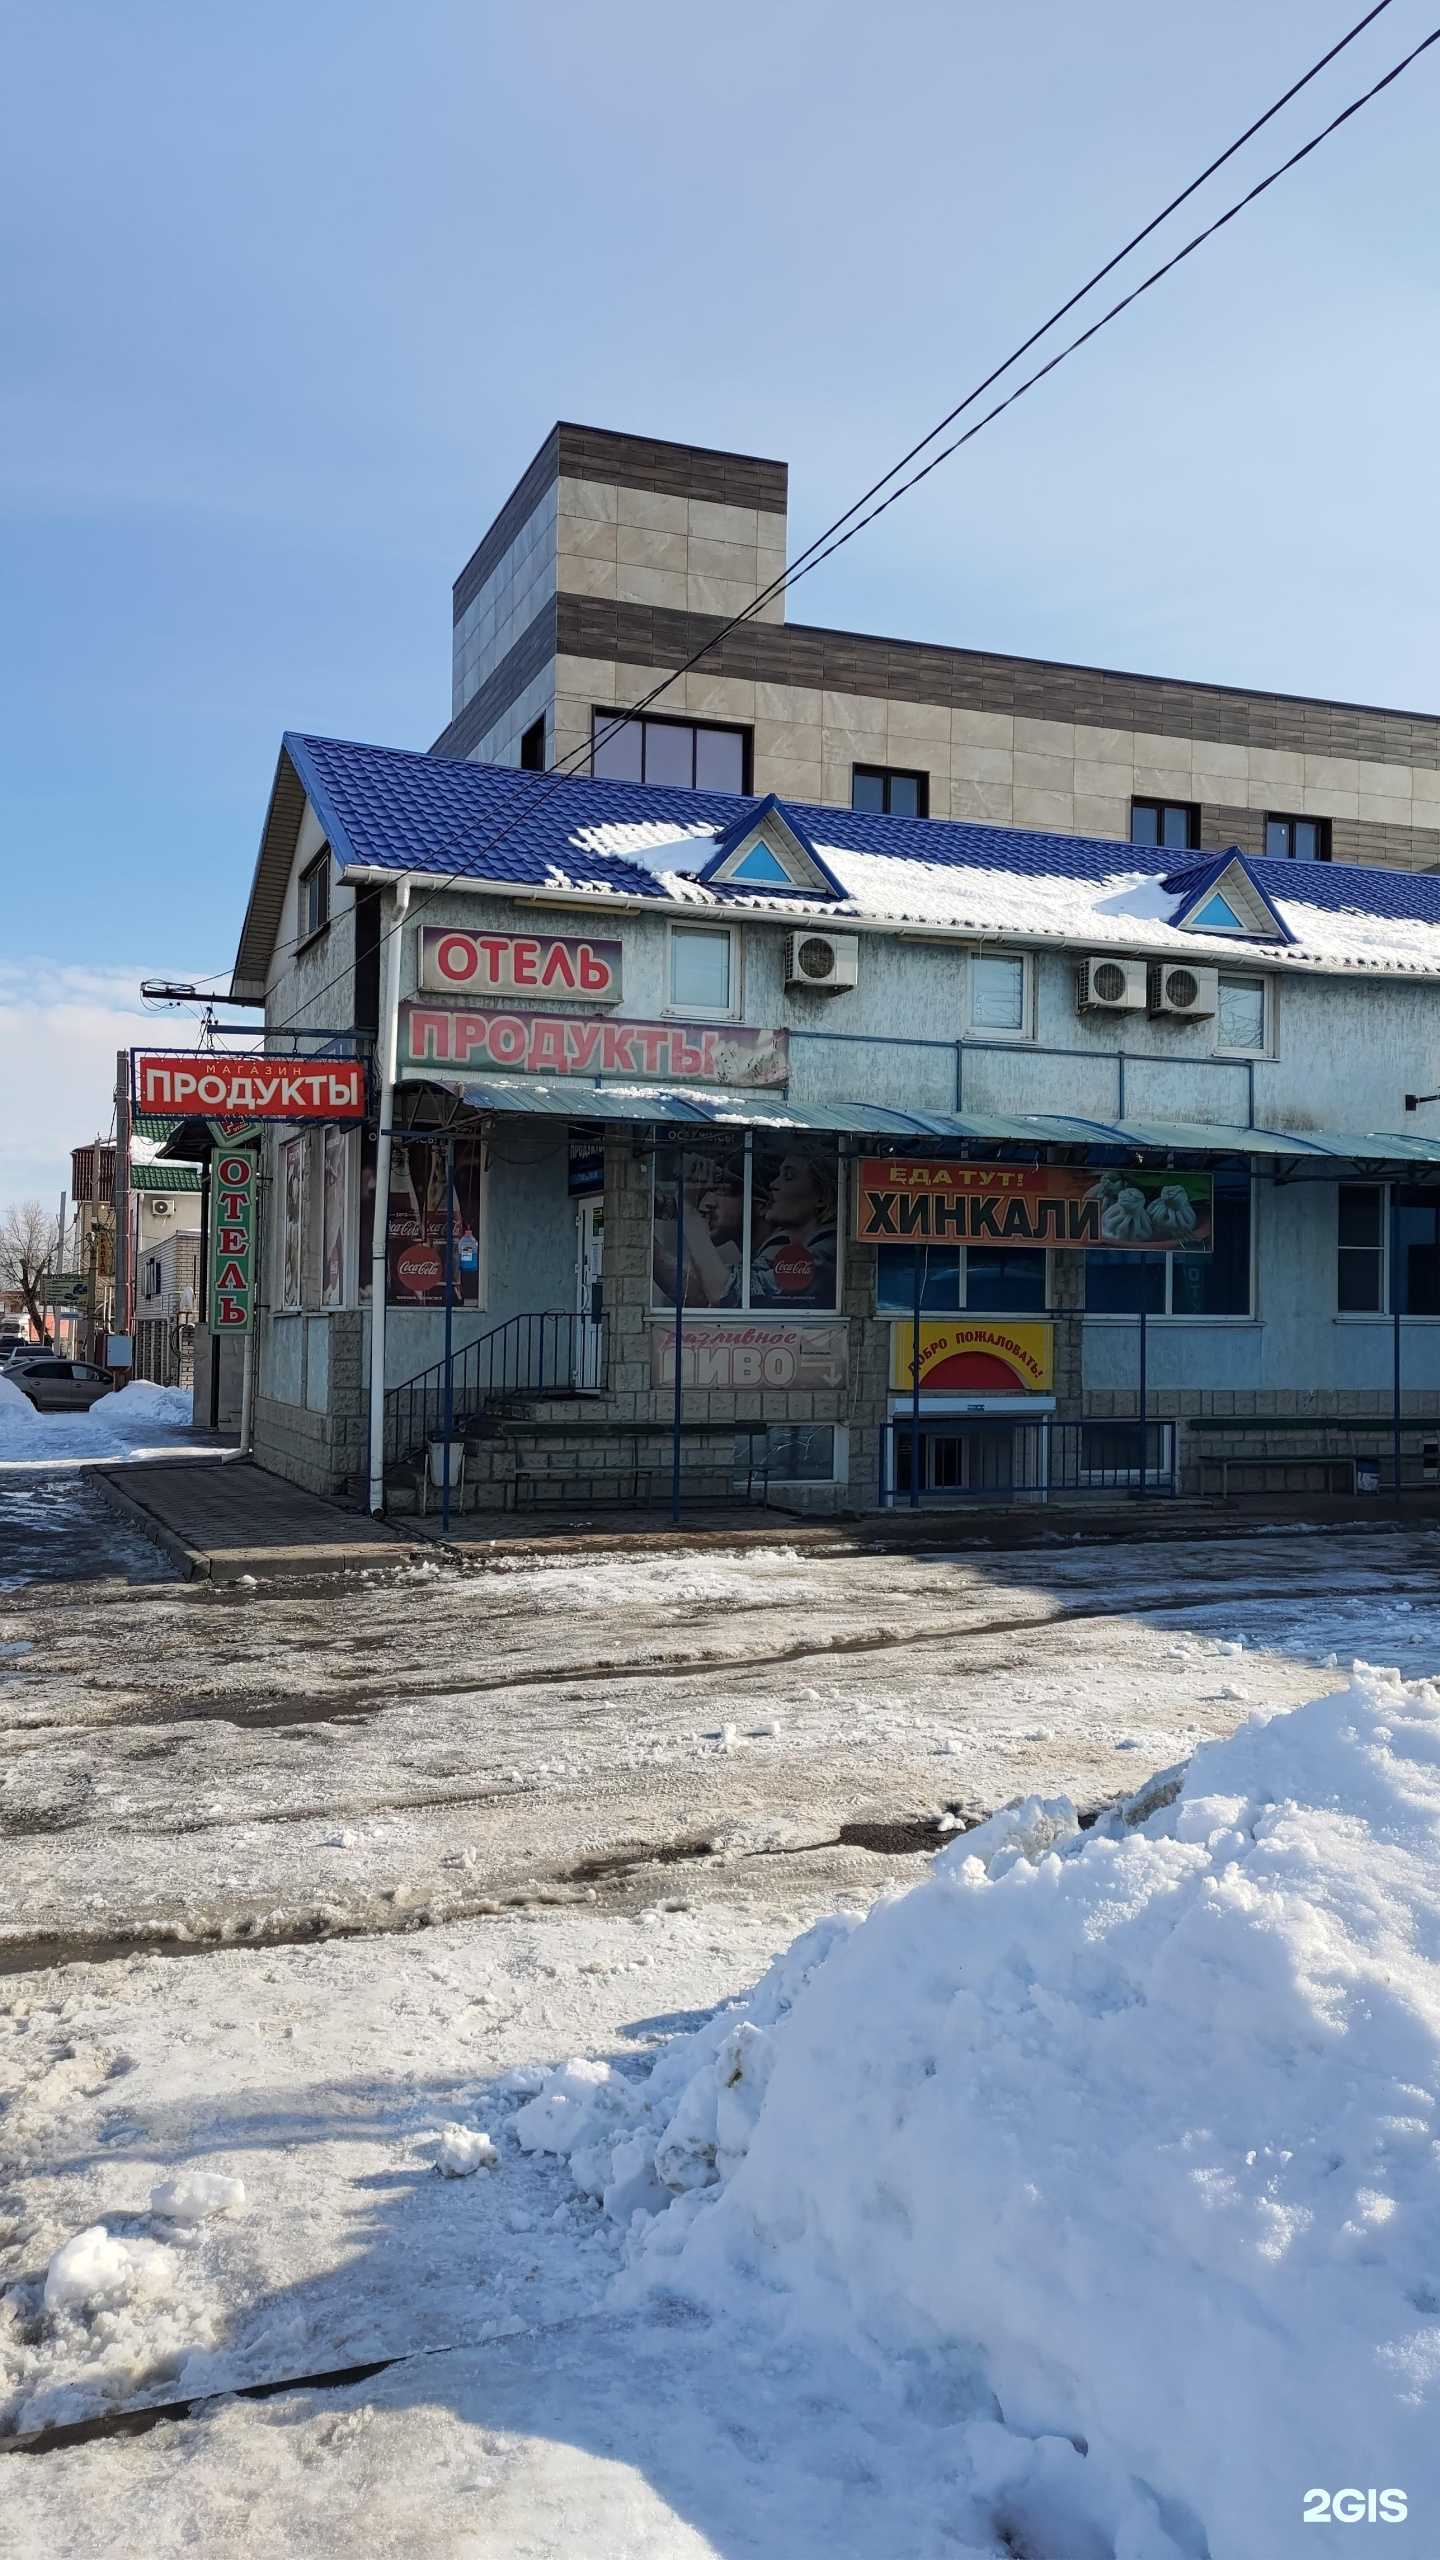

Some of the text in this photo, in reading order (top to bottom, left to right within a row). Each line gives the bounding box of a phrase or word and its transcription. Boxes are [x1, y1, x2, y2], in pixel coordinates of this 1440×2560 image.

[437, 935, 610, 991] ОТЕЛЬ
[410, 1011, 717, 1075] ПРОДУКТЫ
[146, 1068, 358, 1110] ПРОДУКТЫ
[206, 1064, 302, 1076] МАГАЗИН
[889, 1167, 1025, 1188] ЕДА ТУТ!
[863, 1190, 1103, 1241] ХИНКАЛИ
[217, 1157, 251, 1326] ОТЕЛЬ
[662, 1346, 796, 1386] ПИВО
[956, 1330, 1044, 1378] ПОЖАЛОВАТЬ!
